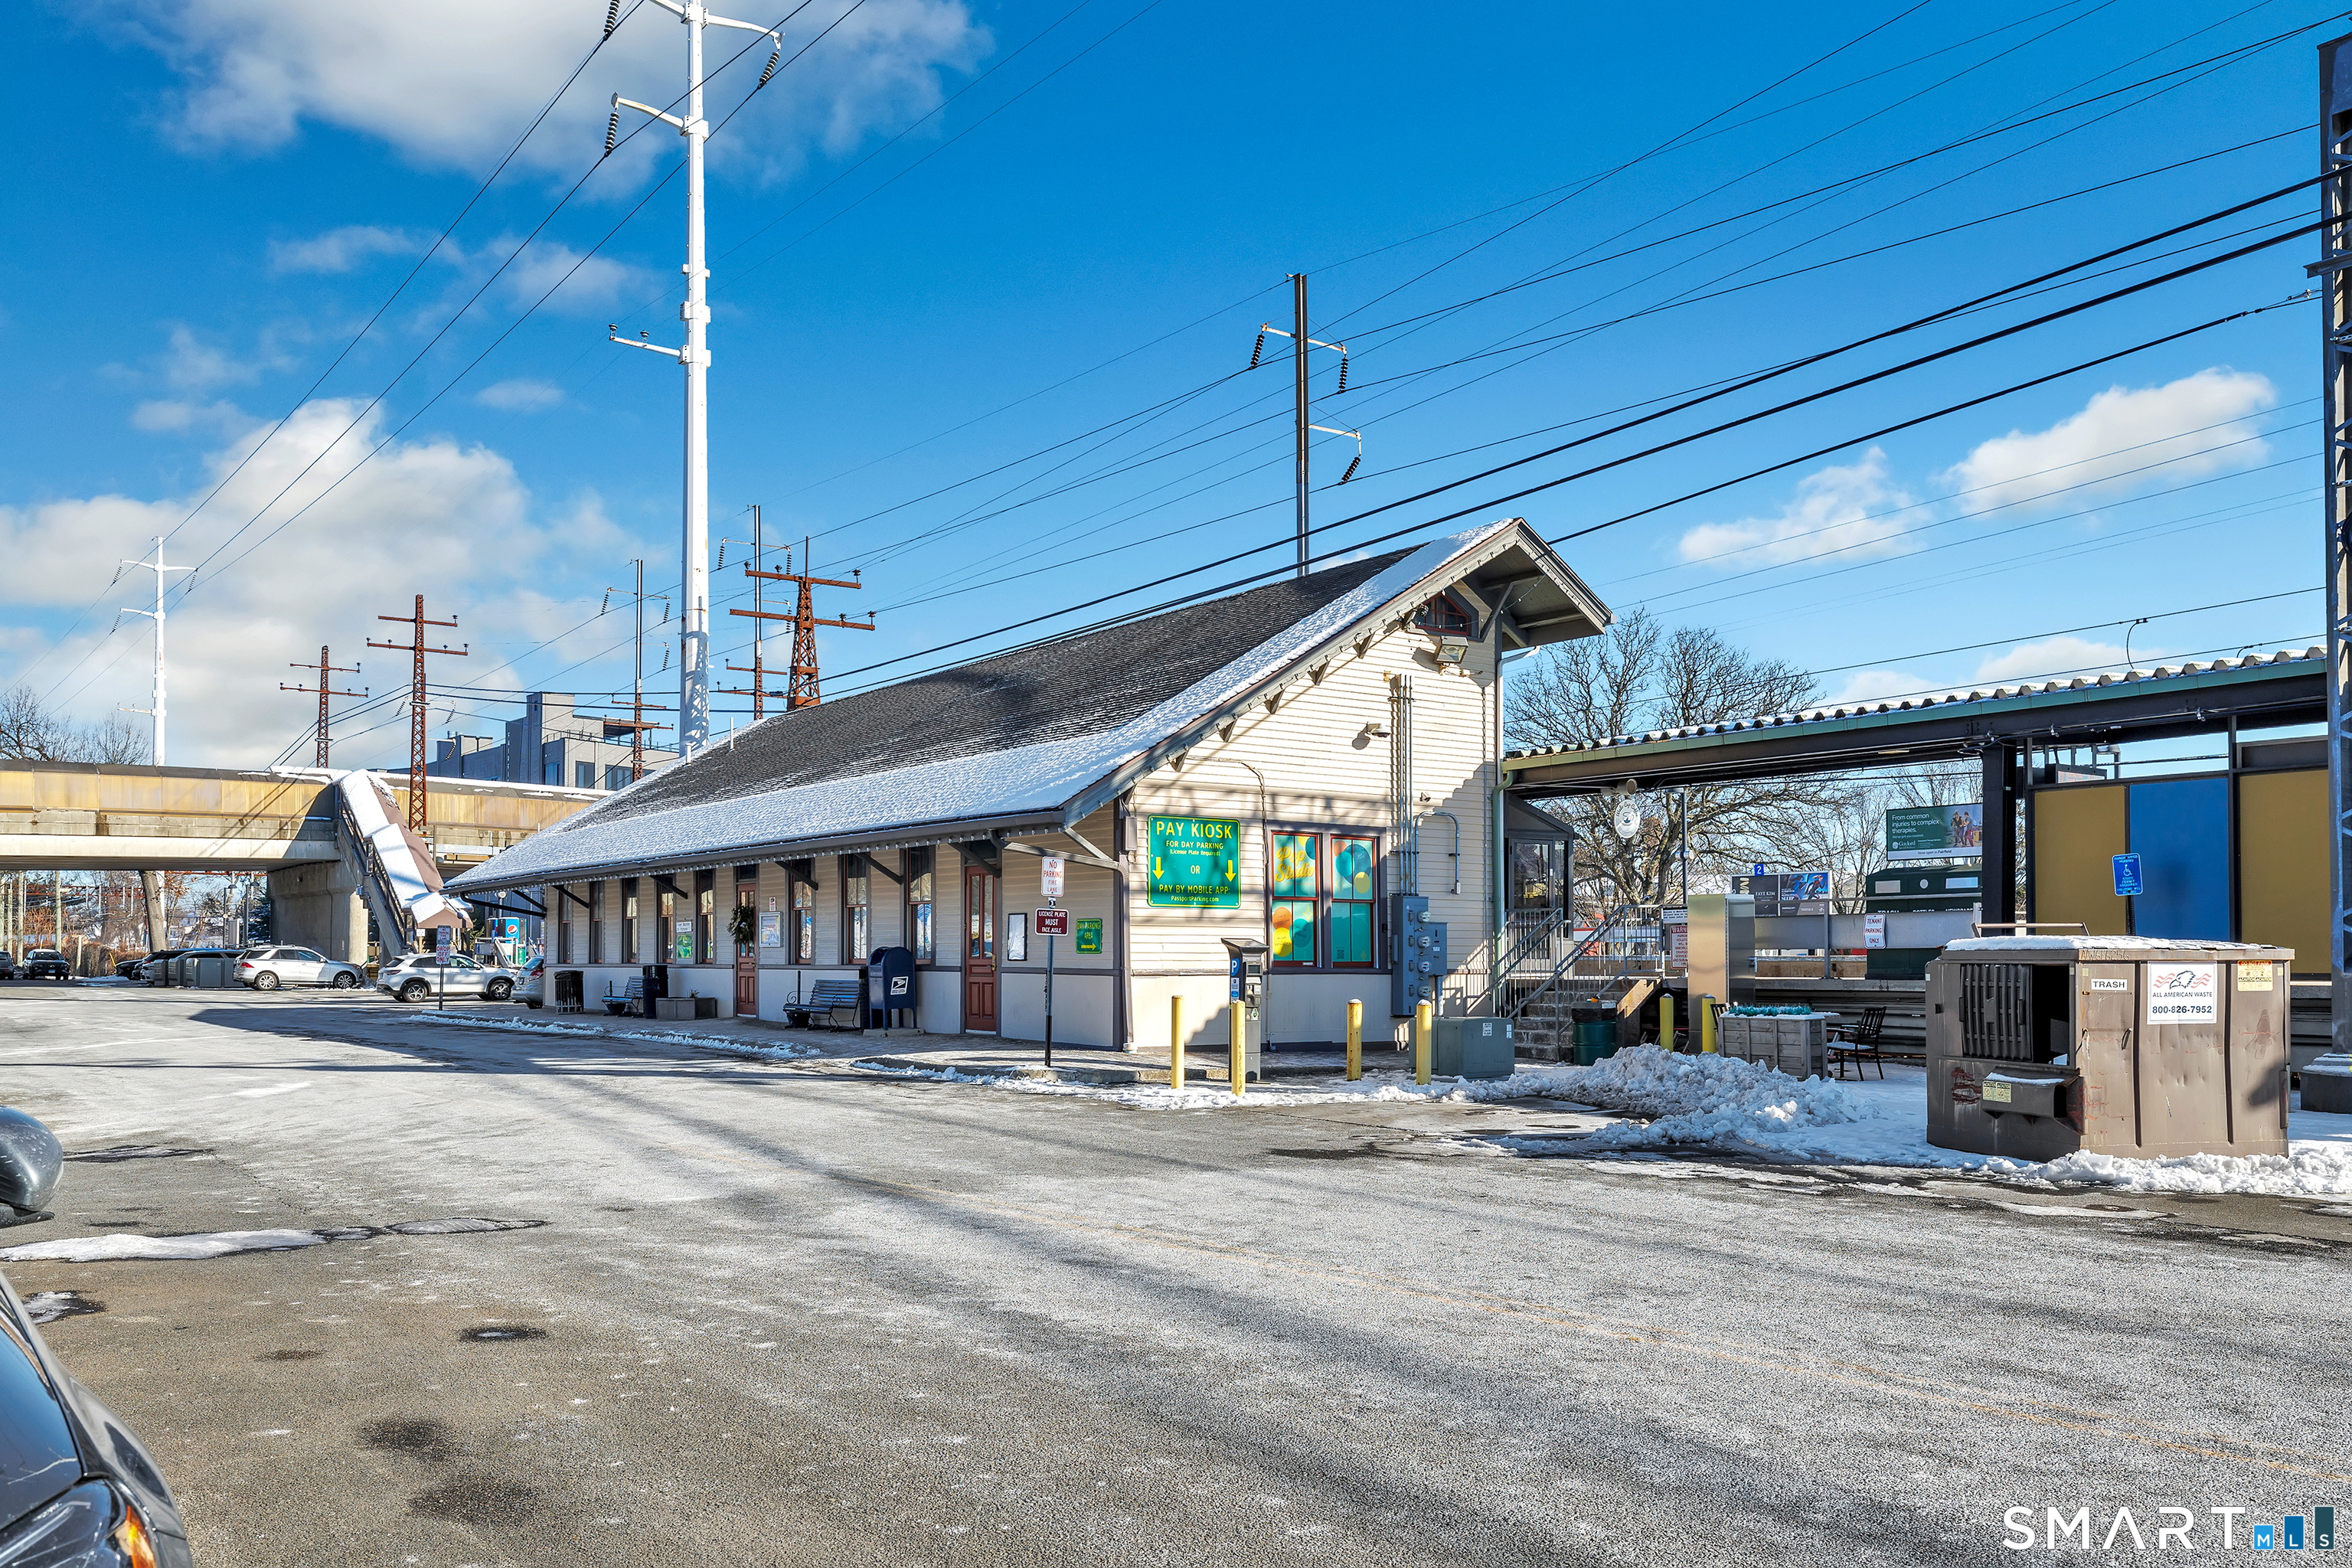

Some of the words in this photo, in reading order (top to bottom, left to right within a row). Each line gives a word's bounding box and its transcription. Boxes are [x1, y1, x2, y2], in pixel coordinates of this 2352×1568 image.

[1917, 818, 1939, 827] complex
[1156, 821, 1184, 836] PAY
[1191, 823, 1232, 838] KIOSK
[1276, 846, 1306, 866] Pop
[1190, 865, 1200, 874] OR
[1275, 863, 1315, 882] Studio
[1757, 866, 1762, 874] 2
[1044, 870, 1063, 879] PARKING
[1187, 885, 1212, 893] MOBILE
[1215, 886, 1230, 894] APP:
[2152, 1005, 2212, 1014] 800-826-7952
